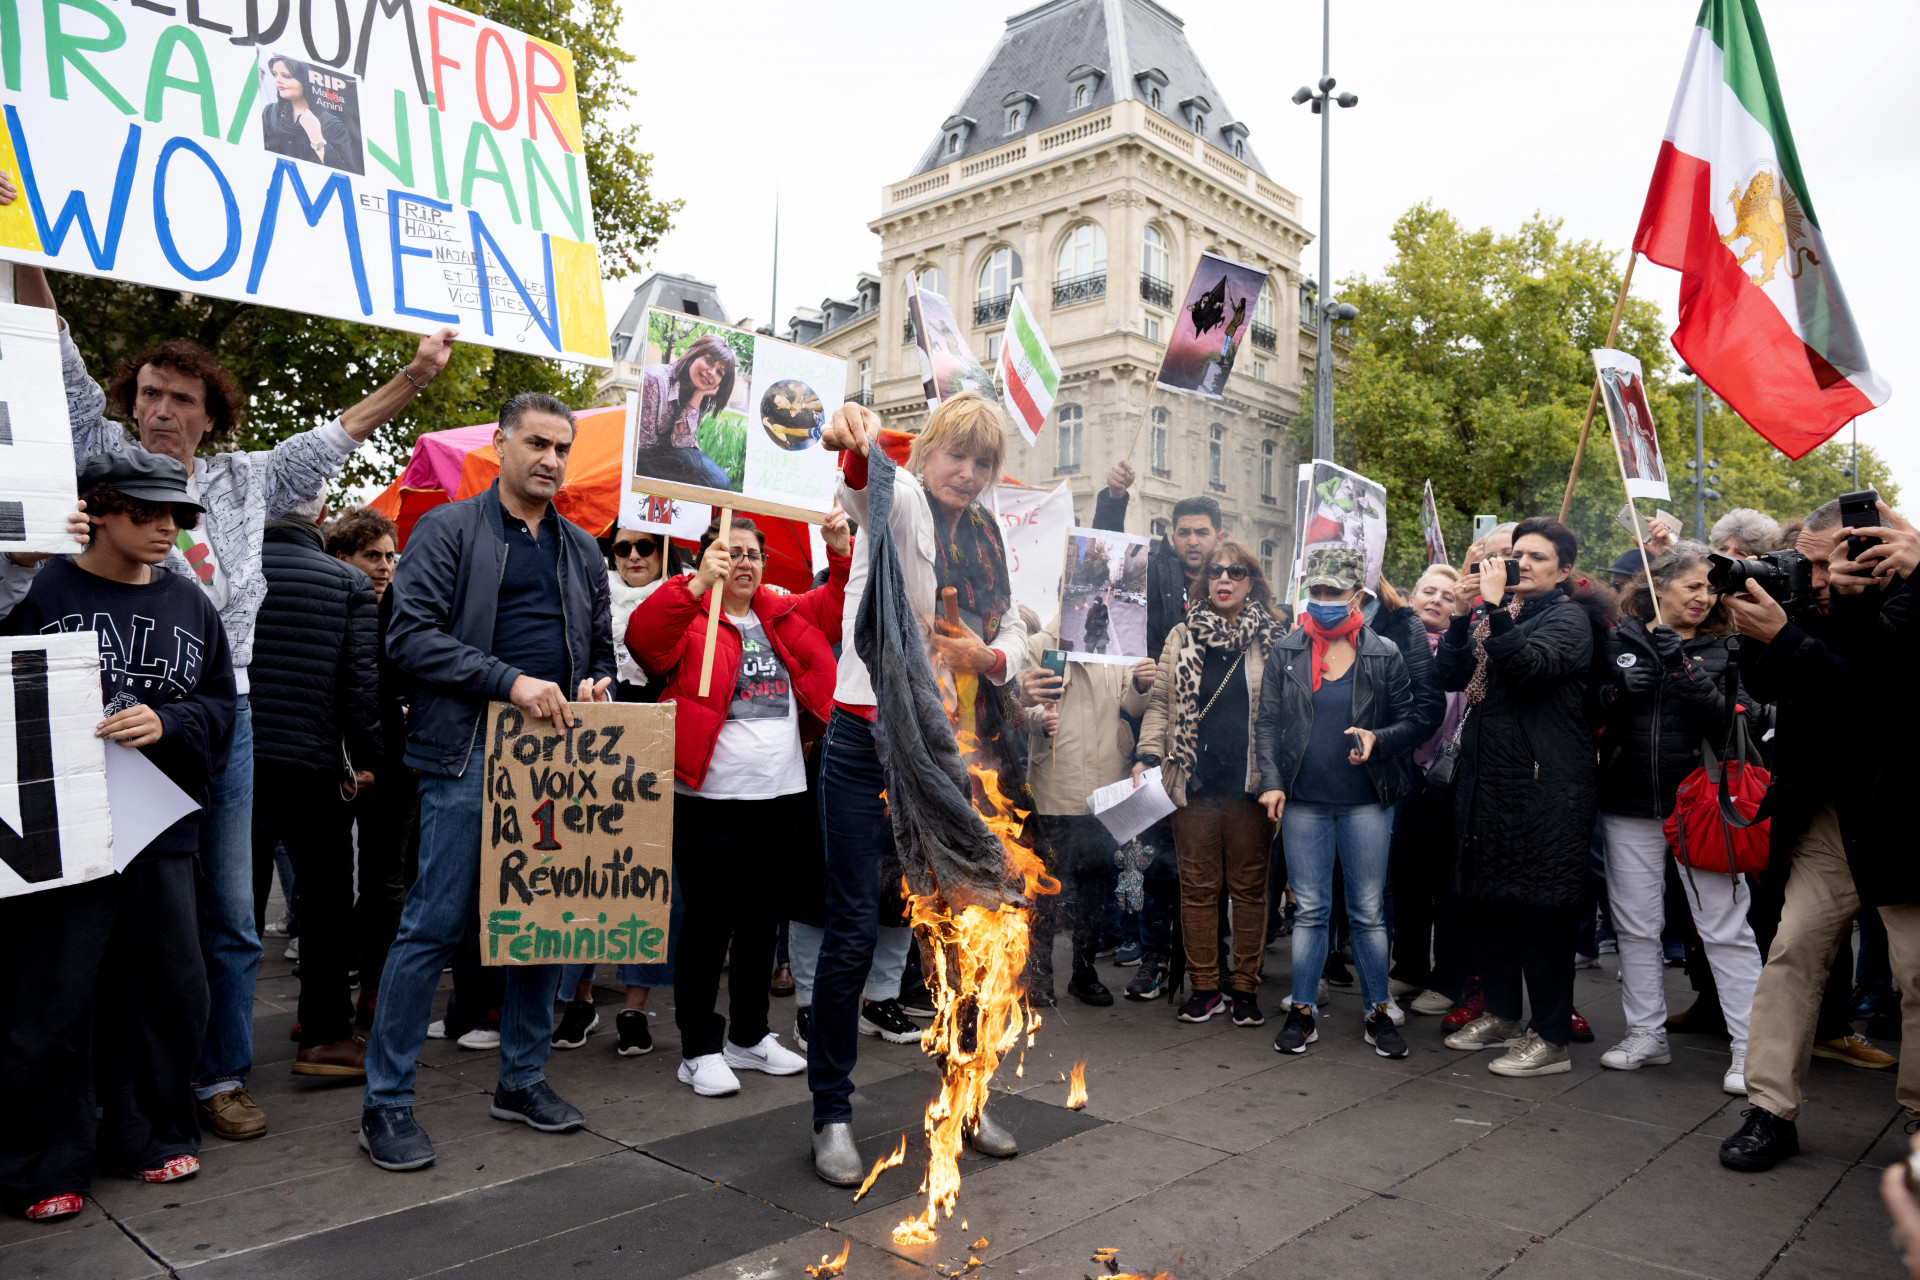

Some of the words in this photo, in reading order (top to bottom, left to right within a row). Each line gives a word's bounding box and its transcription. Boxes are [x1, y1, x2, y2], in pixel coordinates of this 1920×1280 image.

[308, 69, 347, 91] RIP
[428, 5, 573, 153] FOR
[316, 97, 343, 112] Amini
[360, 194, 384, 209] ET
[5, 105, 563, 353] WOMEN
[444, 270, 462, 281] ET
[524, 278, 545, 294] LES
[755, 469, 822, 499] NEDA
[494, 707, 626, 767] Portez
[487, 754, 517, 803] la
[530, 766, 598, 801] voix
[611, 755, 662, 802] de
[491, 801, 523, 849] la
[499, 846, 670, 906] Révolution
[487, 910, 665, 963] Féministe
